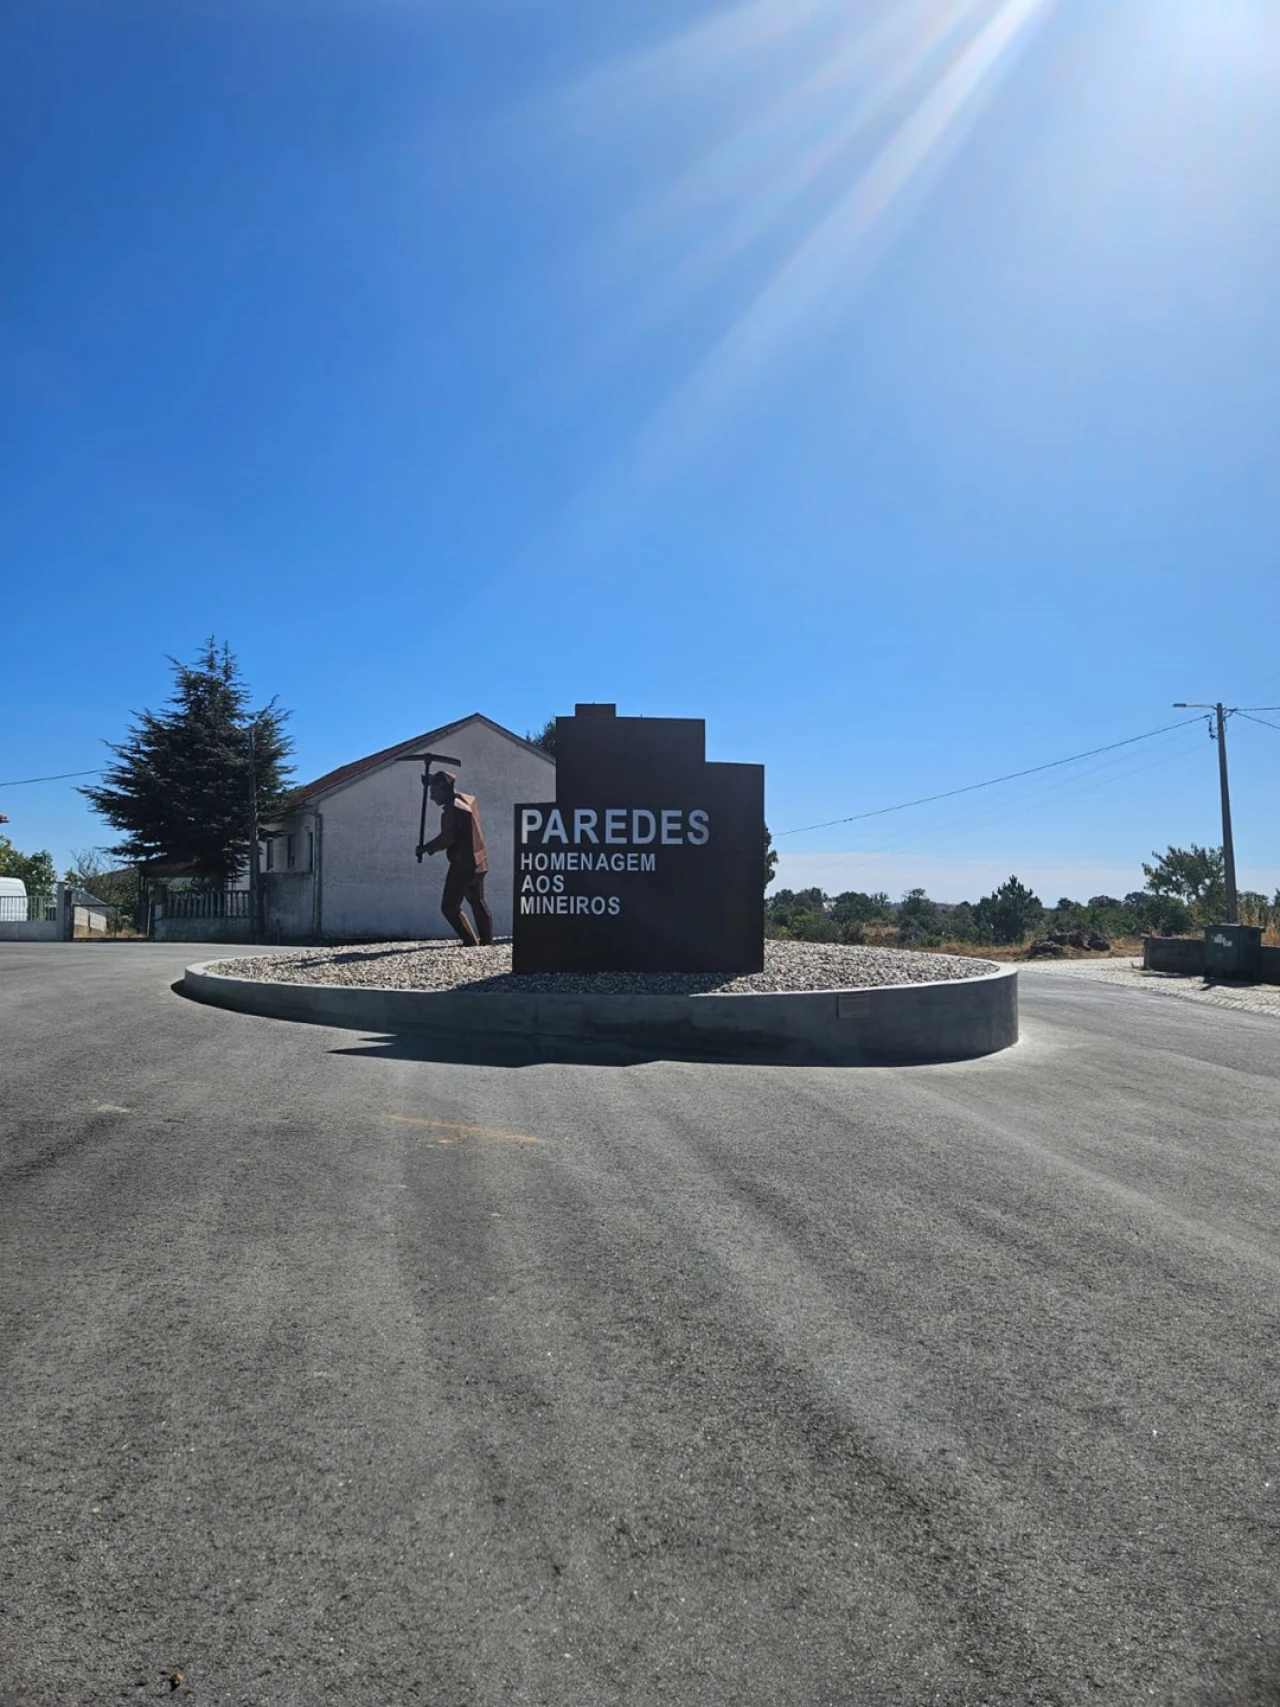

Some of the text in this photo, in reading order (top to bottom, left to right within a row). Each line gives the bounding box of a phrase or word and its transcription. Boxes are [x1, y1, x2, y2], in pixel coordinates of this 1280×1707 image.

[521, 809, 710, 845] PAREDES
[520, 853, 656, 871] HOMENAGEM
[521, 874, 564, 893] AOS
[520, 896, 621, 915] MINEIROS
